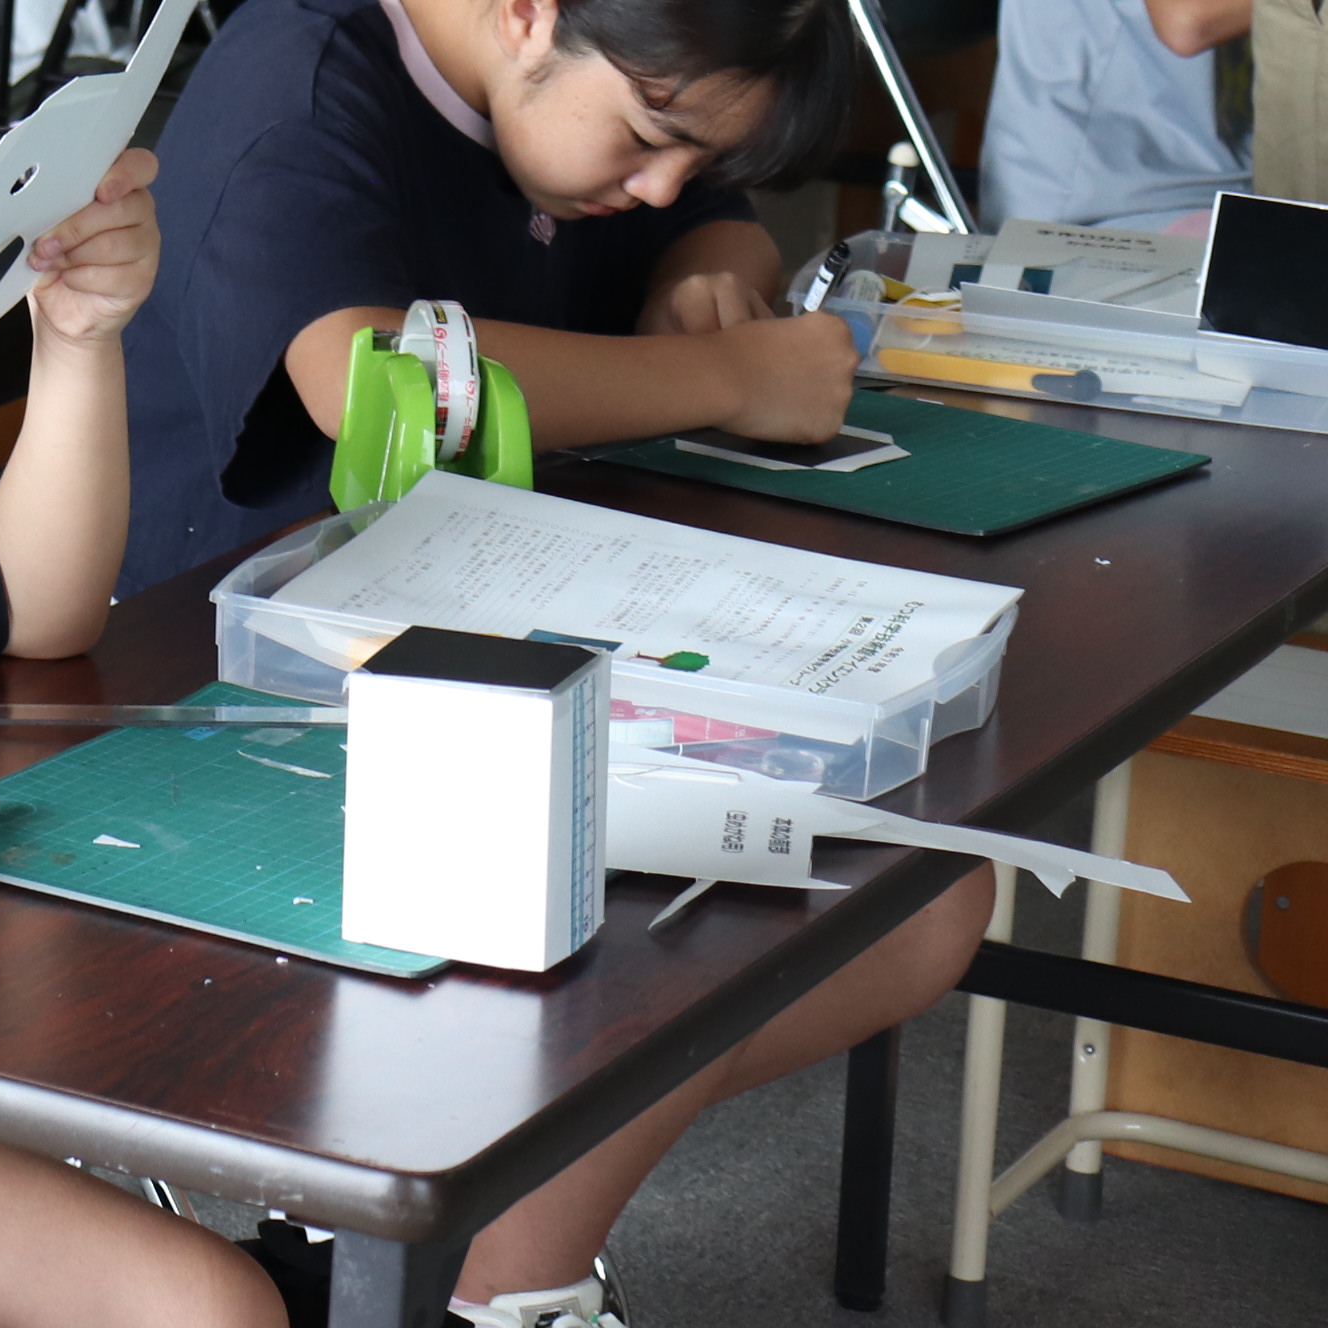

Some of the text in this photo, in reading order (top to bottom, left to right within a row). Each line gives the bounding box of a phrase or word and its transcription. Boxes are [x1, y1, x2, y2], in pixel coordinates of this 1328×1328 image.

[808, 601, 926, 695] むつ科学技術館サイエンスクラ
